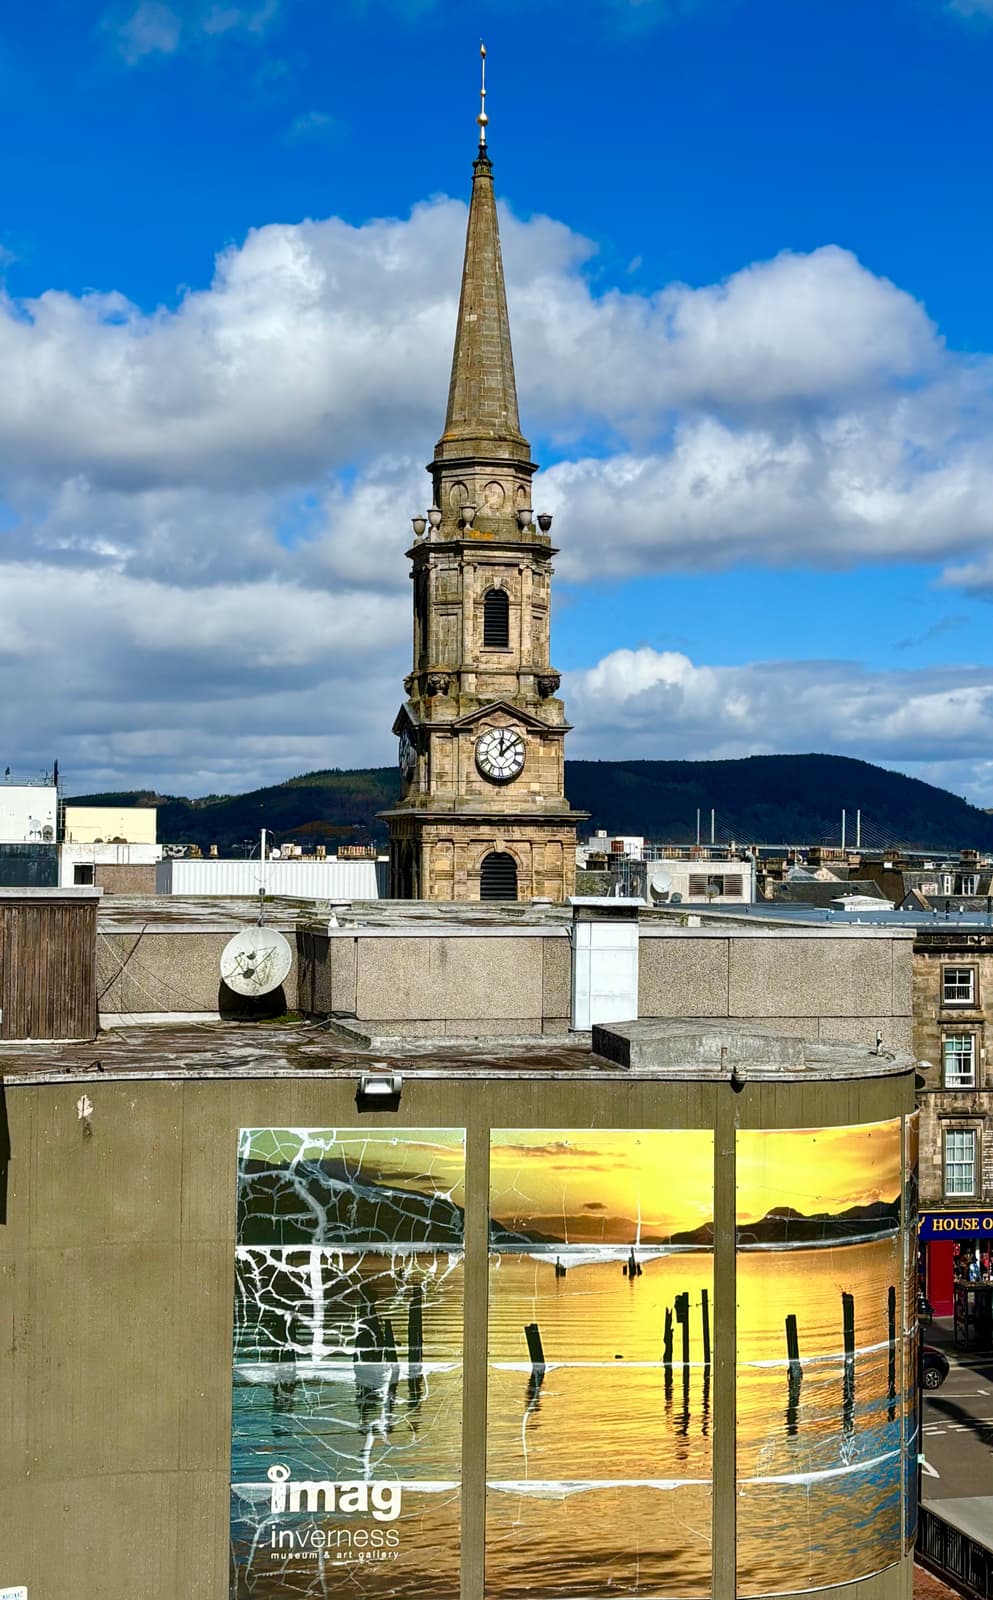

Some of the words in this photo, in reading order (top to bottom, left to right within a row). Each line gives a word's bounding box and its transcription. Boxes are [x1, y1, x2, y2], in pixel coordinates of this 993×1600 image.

[932, 1217, 980, 1231] HOUSE
[267, 1463, 402, 1521] imag
[271, 1525, 400, 1548] inverness
[271, 1551, 318, 1559] museum
[324, 1551, 331, 1559] &
[336, 1551, 353, 1559] art
[358, 1551, 400, 1561] gallery
